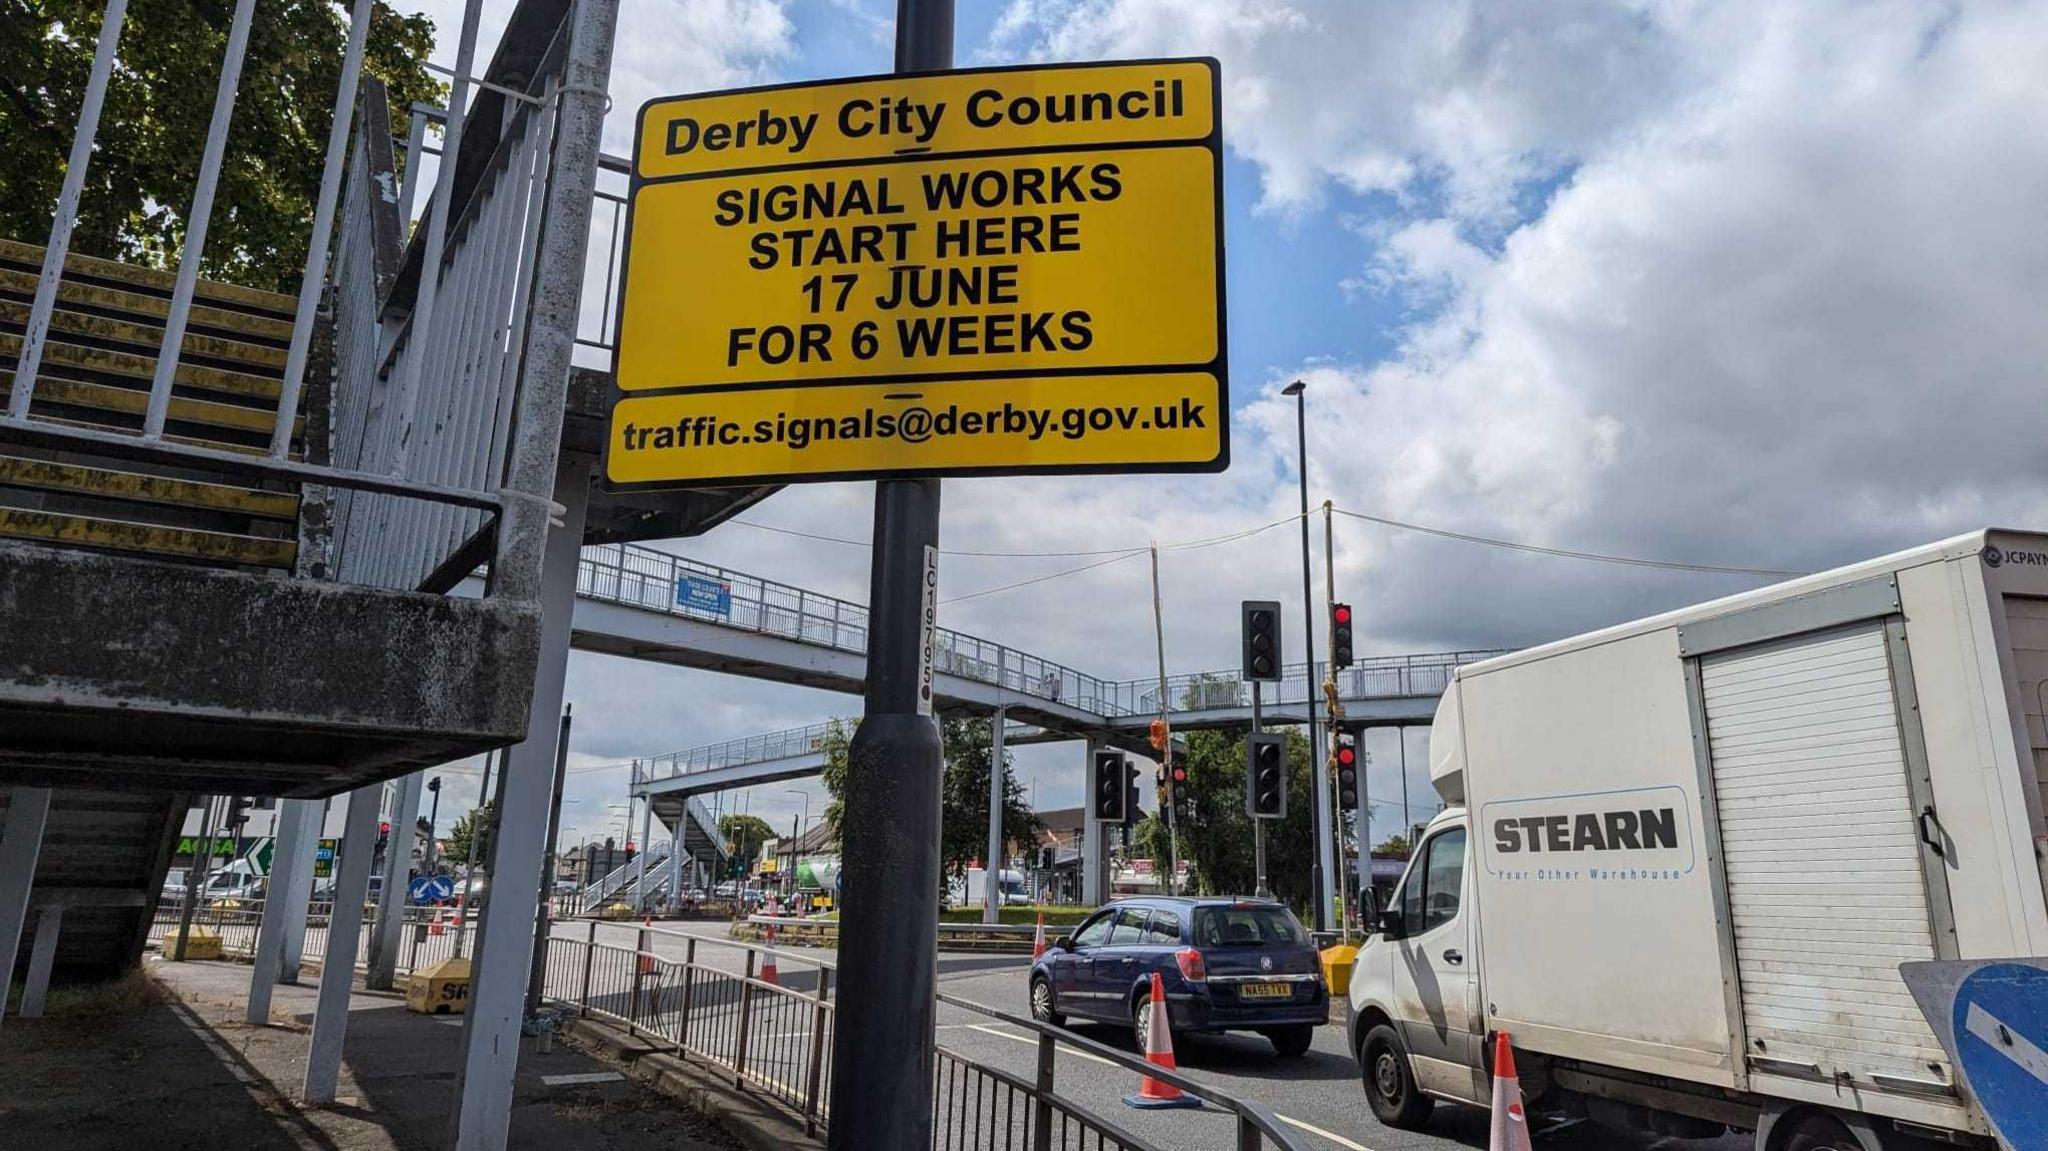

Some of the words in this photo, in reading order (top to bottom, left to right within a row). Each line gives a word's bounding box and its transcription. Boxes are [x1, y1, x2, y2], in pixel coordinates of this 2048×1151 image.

[665, 109, 819, 156] Derby
[838, 96, 946, 144] City
[966, 79, 1183, 128] Council
[714, 177, 905, 227] SIGNAL
[921, 163, 1122, 212] WORKS
[749, 223, 917, 270] START
[936, 213, 1081, 259] HERE
[802, 273, 859, 314] 17
[875, 265, 1019, 311] JUNE
[727, 324, 833, 367] FOR
[851, 320, 879, 361] 6
[896, 310, 1093, 358] WEEKS
[623, 397, 1206, 451] traffic.signals@derby.gov.uk
[1494, 808, 1678, 853] STEARN
[1498, 870, 1530, 881] Your
[1538, 869, 1580, 881] Other
[1590, 867, 1681, 880] Warehouse
